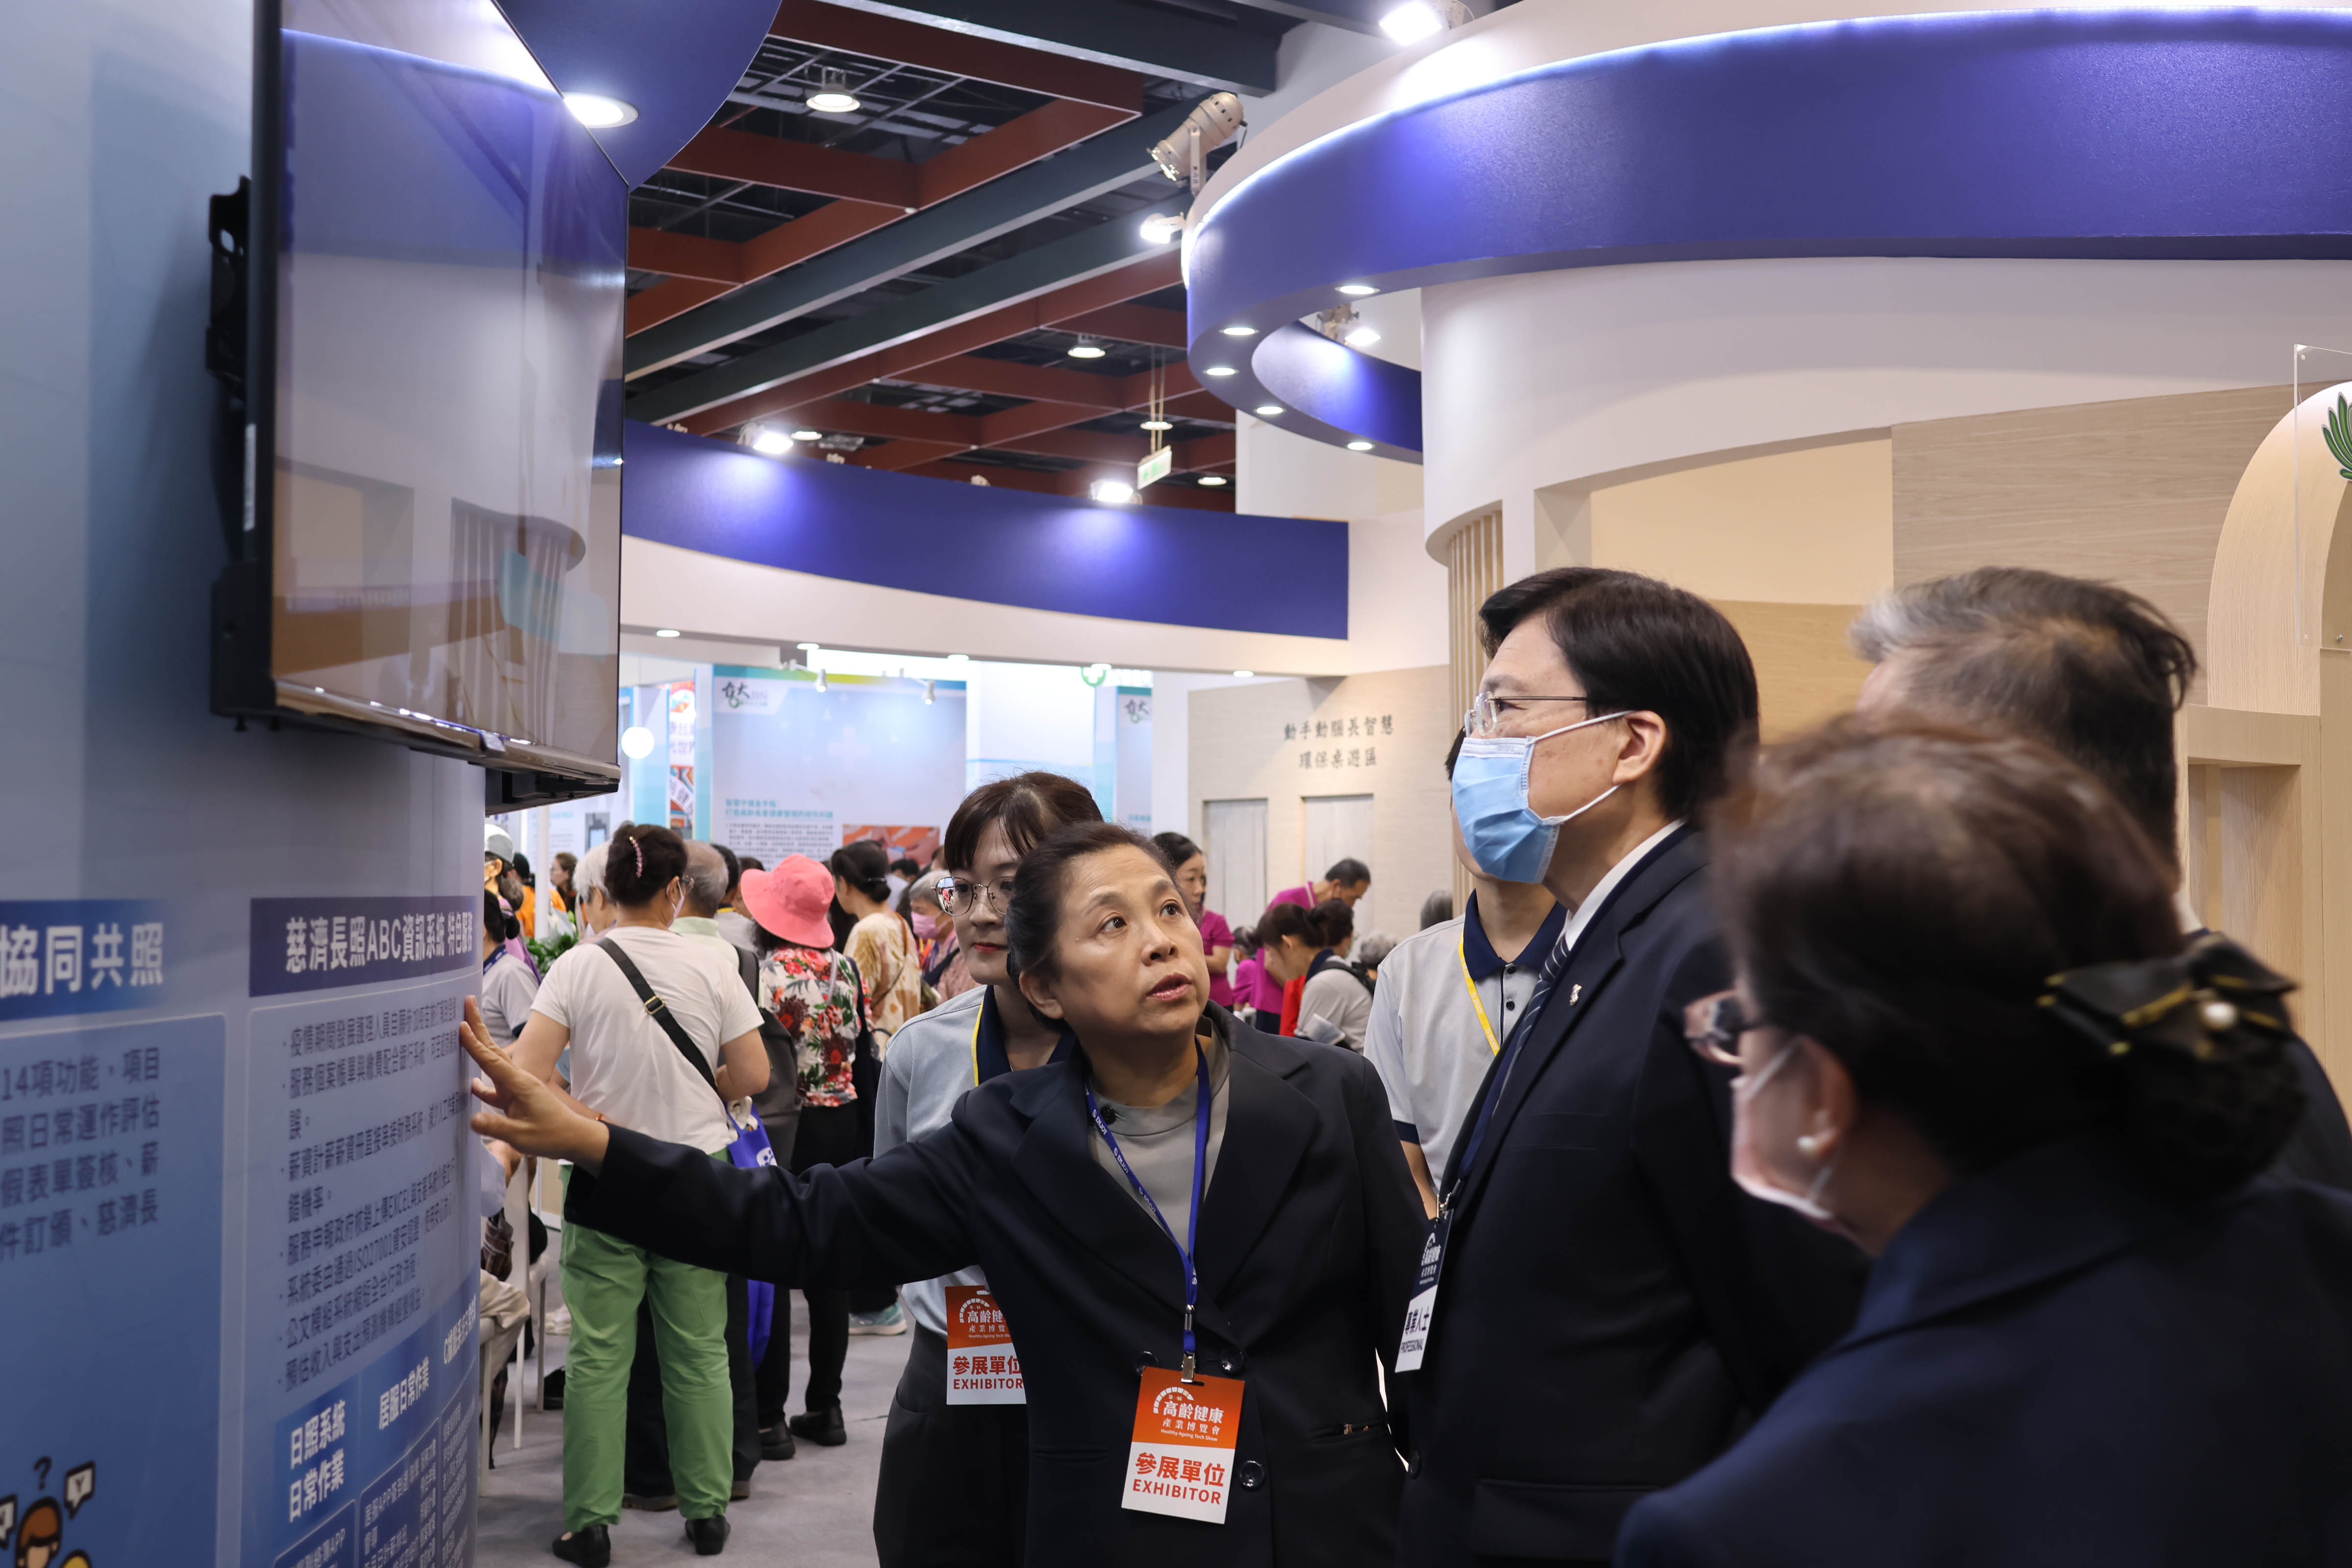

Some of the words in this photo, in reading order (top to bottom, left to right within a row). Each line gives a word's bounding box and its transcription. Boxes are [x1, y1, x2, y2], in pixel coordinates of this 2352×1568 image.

[1284, 713, 1394, 740] 動手動腦長智慧
[1299, 747, 1376, 769] 環保桌遊區
[286, 913, 444, 974] 慈濟長照ABC資訊系統
[447, 911, 472, 956] 特色服務
[0, 923, 163, 998] 協同共照
[1095, 1117, 1107, 1135] ENJOY
[1118, 1155, 1128, 1174] ENJOY
[967, 1310, 1005, 1323] 高齡健
[953, 1355, 1021, 1375] 參展單位
[379, 1356, 429, 1430] 居服日常作業
[954, 1378, 1023, 1389] EXHIBITOR
[1163, 1401, 1224, 1424] 高齡健康
[291, 1399, 346, 1470] 日照系統
[1162, 1418, 1221, 1435] 產業博覽會
[1135, 1452, 1225, 1487] 參展單位
[289, 1448, 344, 1523] 日常作業
[1133, 1479, 1221, 1504] EXHIBITOR
